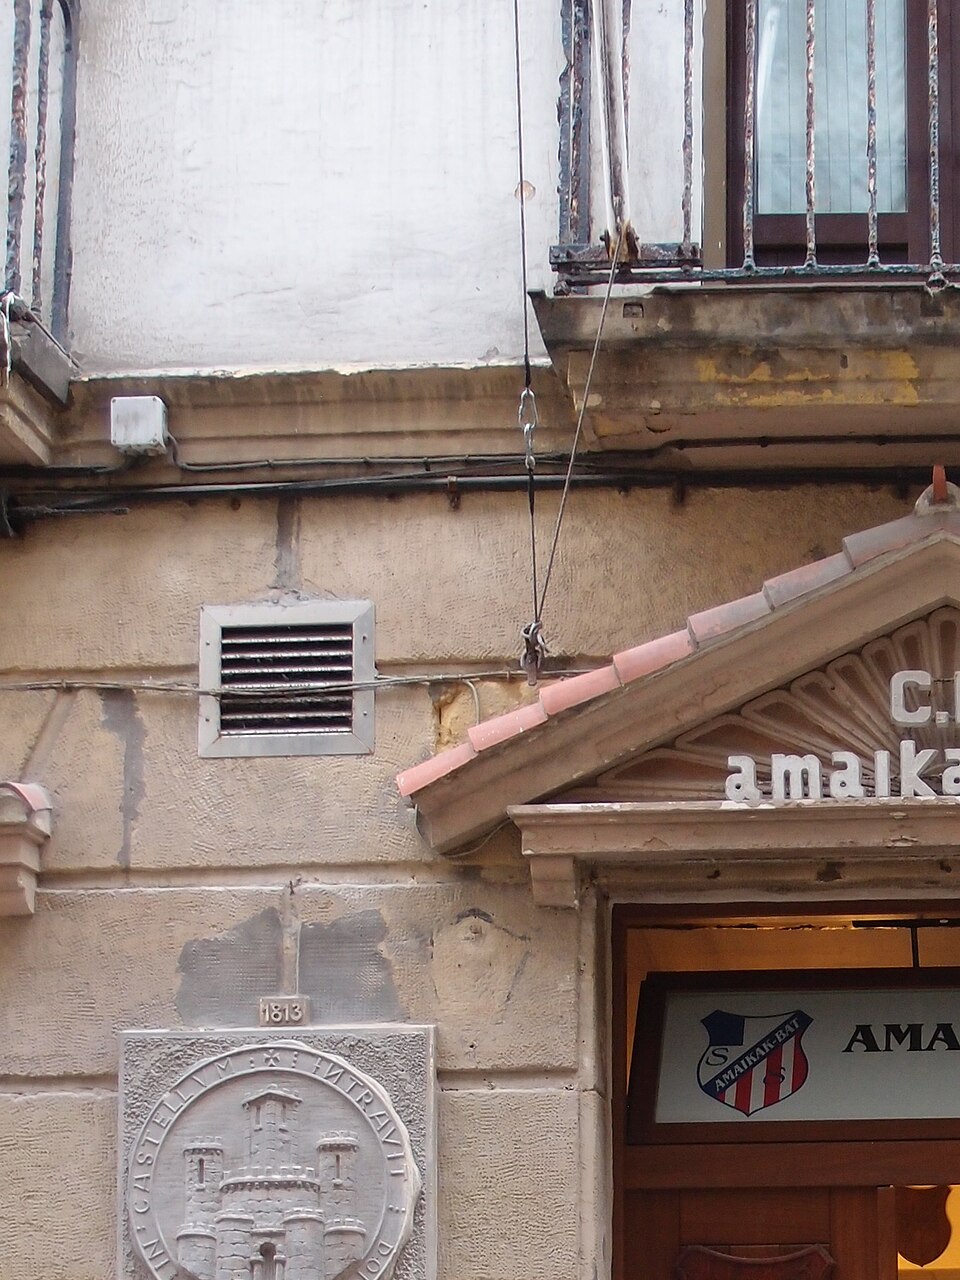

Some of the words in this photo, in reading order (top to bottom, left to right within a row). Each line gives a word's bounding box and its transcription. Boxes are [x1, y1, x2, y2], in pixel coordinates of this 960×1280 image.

[262, 1002, 303, 1023] 1813
[705, 1047, 729, 1066] S
[714, 1017, 801, 1092] AMAIKAK-BAT
